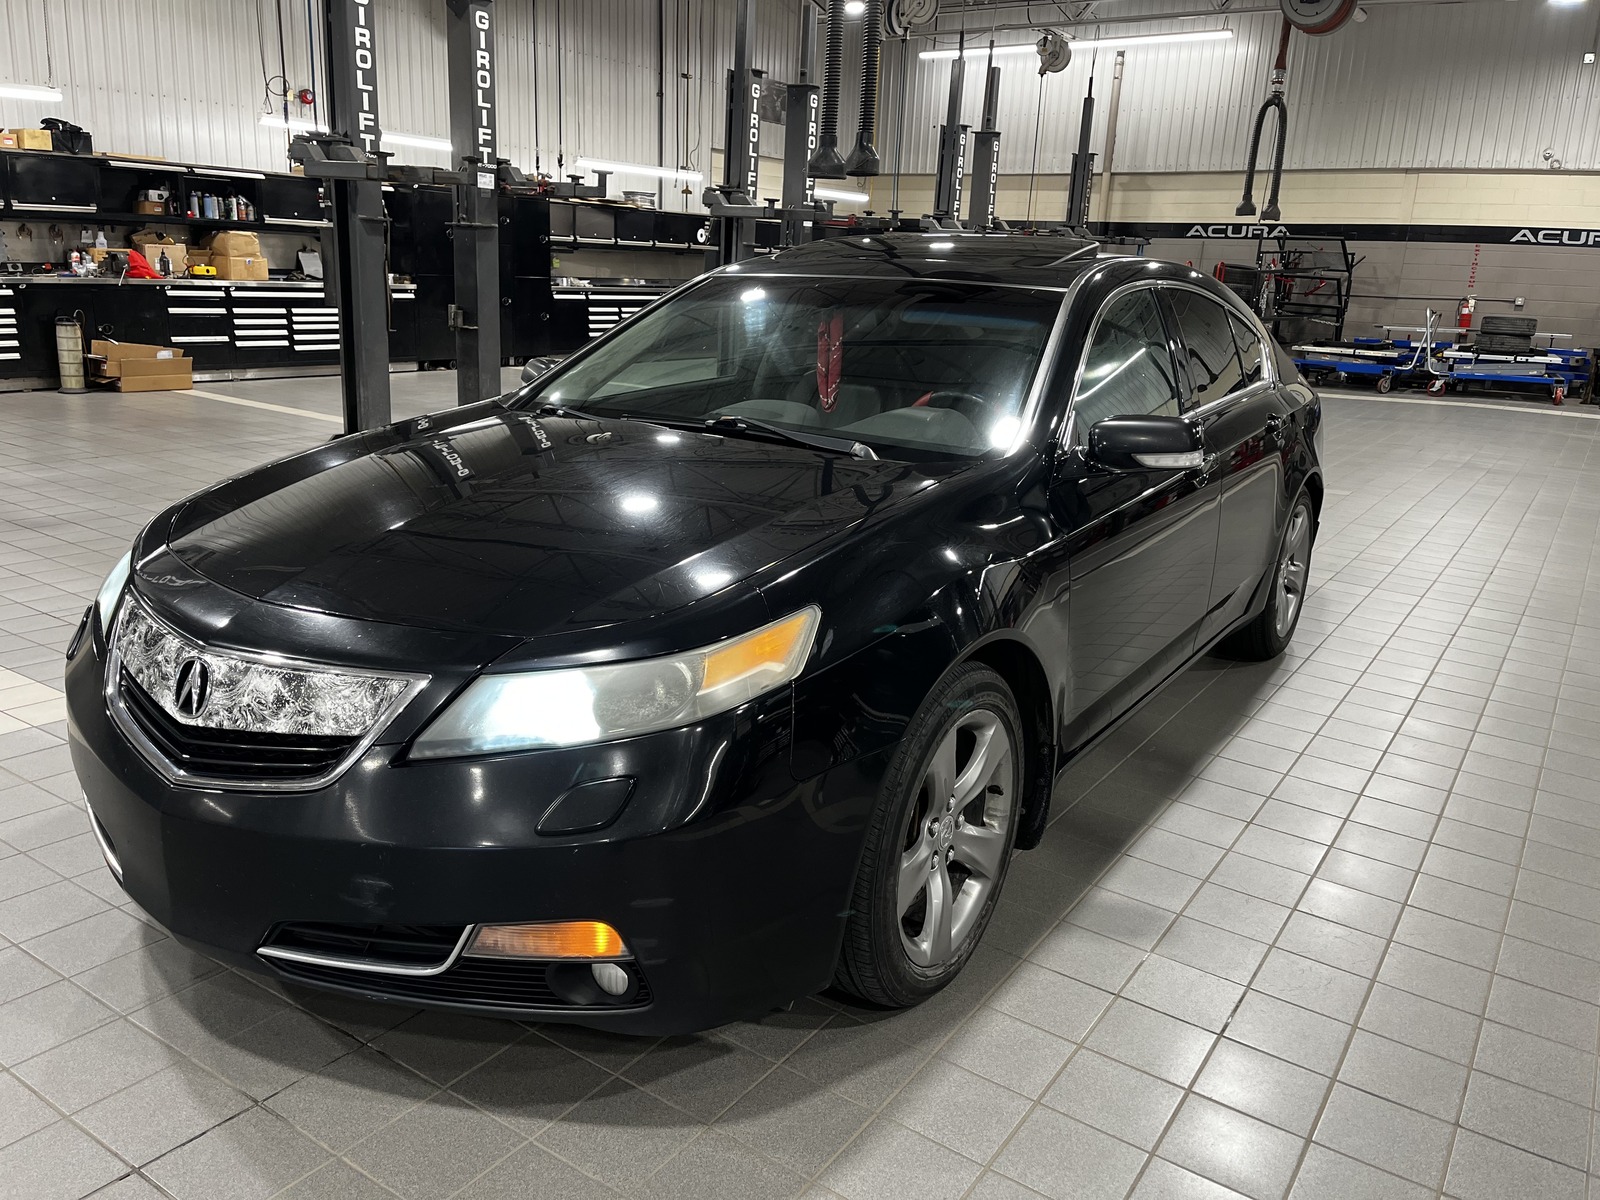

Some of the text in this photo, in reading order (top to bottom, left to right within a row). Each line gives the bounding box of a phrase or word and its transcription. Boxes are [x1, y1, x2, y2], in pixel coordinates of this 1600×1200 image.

[353, 0, 377, 152] IROLIFT
[475, 10, 493, 163] GIROLIFT
[747, 83, 761, 198] GIROLIFT
[953, 133, 966, 222] GIROLIFT
[987, 140, 999, 226] GIROLIFT
[1185, 225, 1290, 238] ACURA
